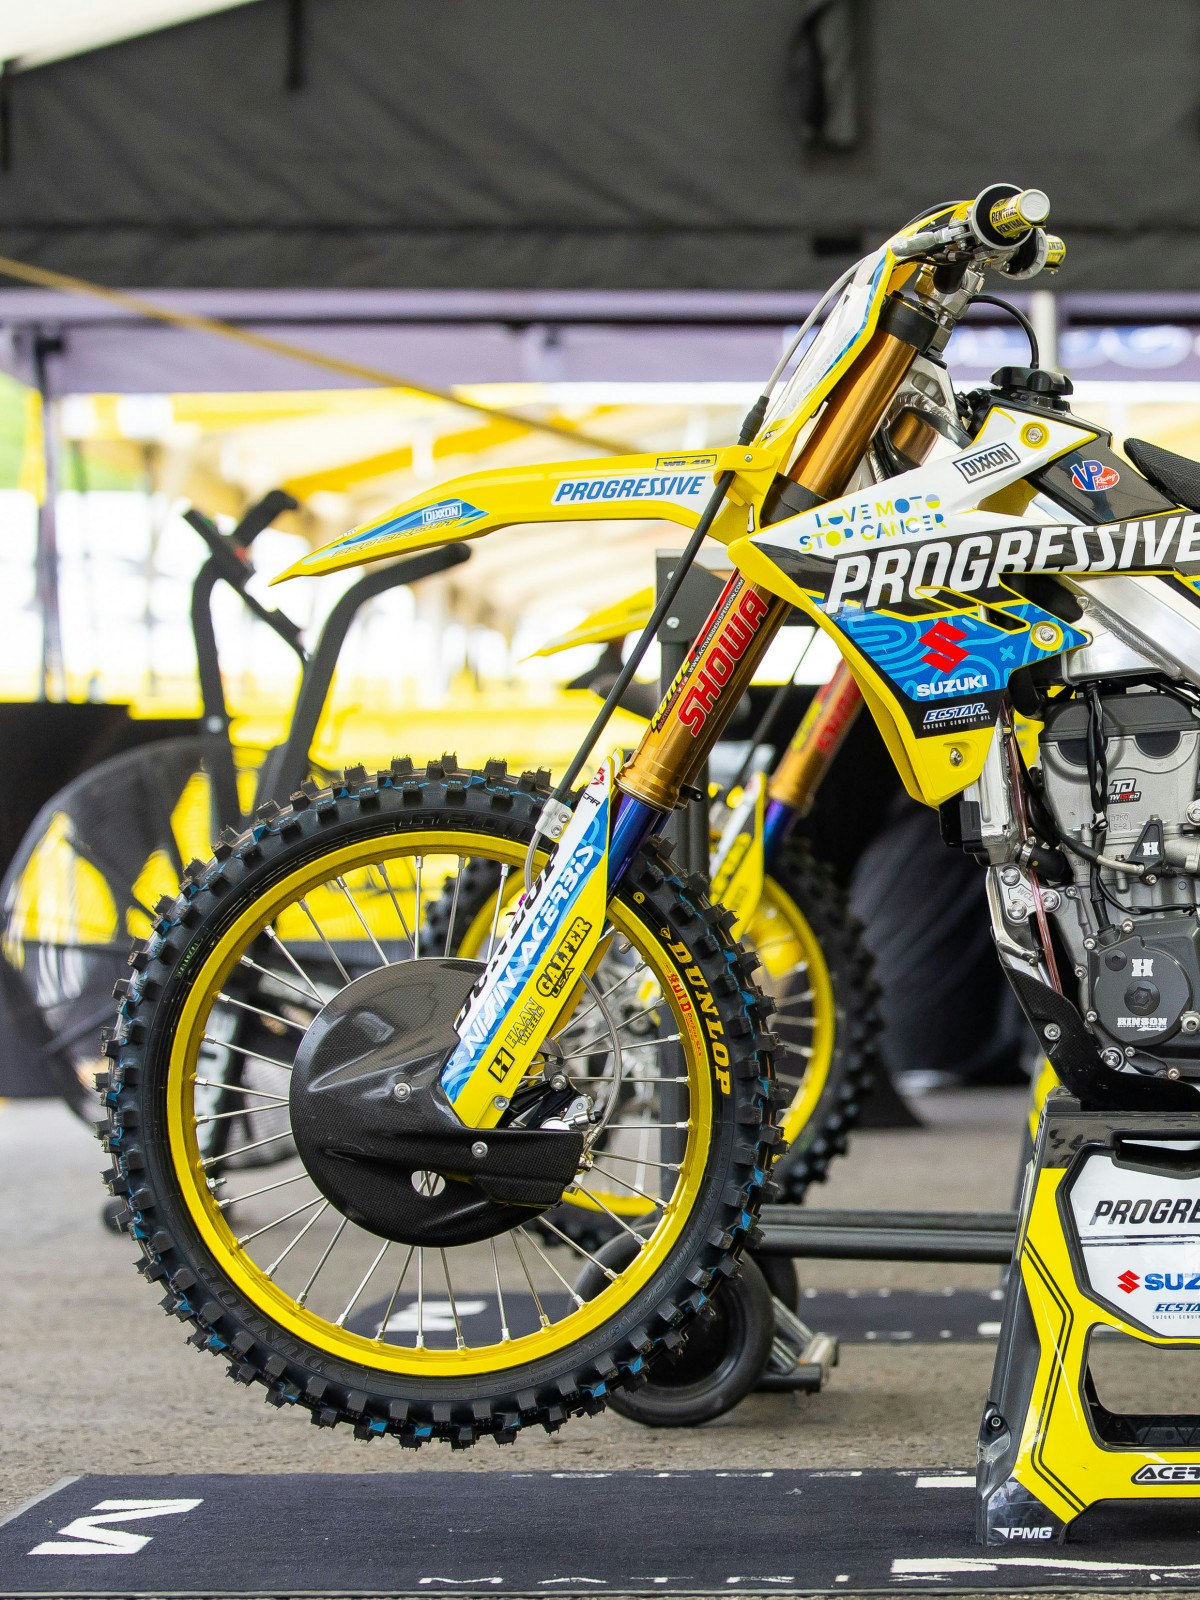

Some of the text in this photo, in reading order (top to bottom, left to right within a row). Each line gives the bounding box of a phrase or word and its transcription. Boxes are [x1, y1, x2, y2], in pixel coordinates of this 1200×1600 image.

[960, 446, 1013, 482] DIXXON
[1070, 460, 1104, 491] VP
[555, 476, 706, 502] PROGRESSIVE
[815, 493, 941, 528] LOVE MOTO
[799, 512, 948, 553] STOP CANCER
[677, 588, 769, 738] SHOWA
[916, 674, 988, 697] SUZUKI
[922, 702, 989, 724] ECSTAR
[536, 916, 593, 998] GALFER
[550, 965, 575, 998] USA
[505, 996, 540, 1049] HAAN
[517, 1002, 546, 1046] WHEELS
[667, 941, 731, 1095] DUNLOP
[1117, 1017, 1168, 1028] HINSON
[1009, 1527, 1053, 1539] PMG
